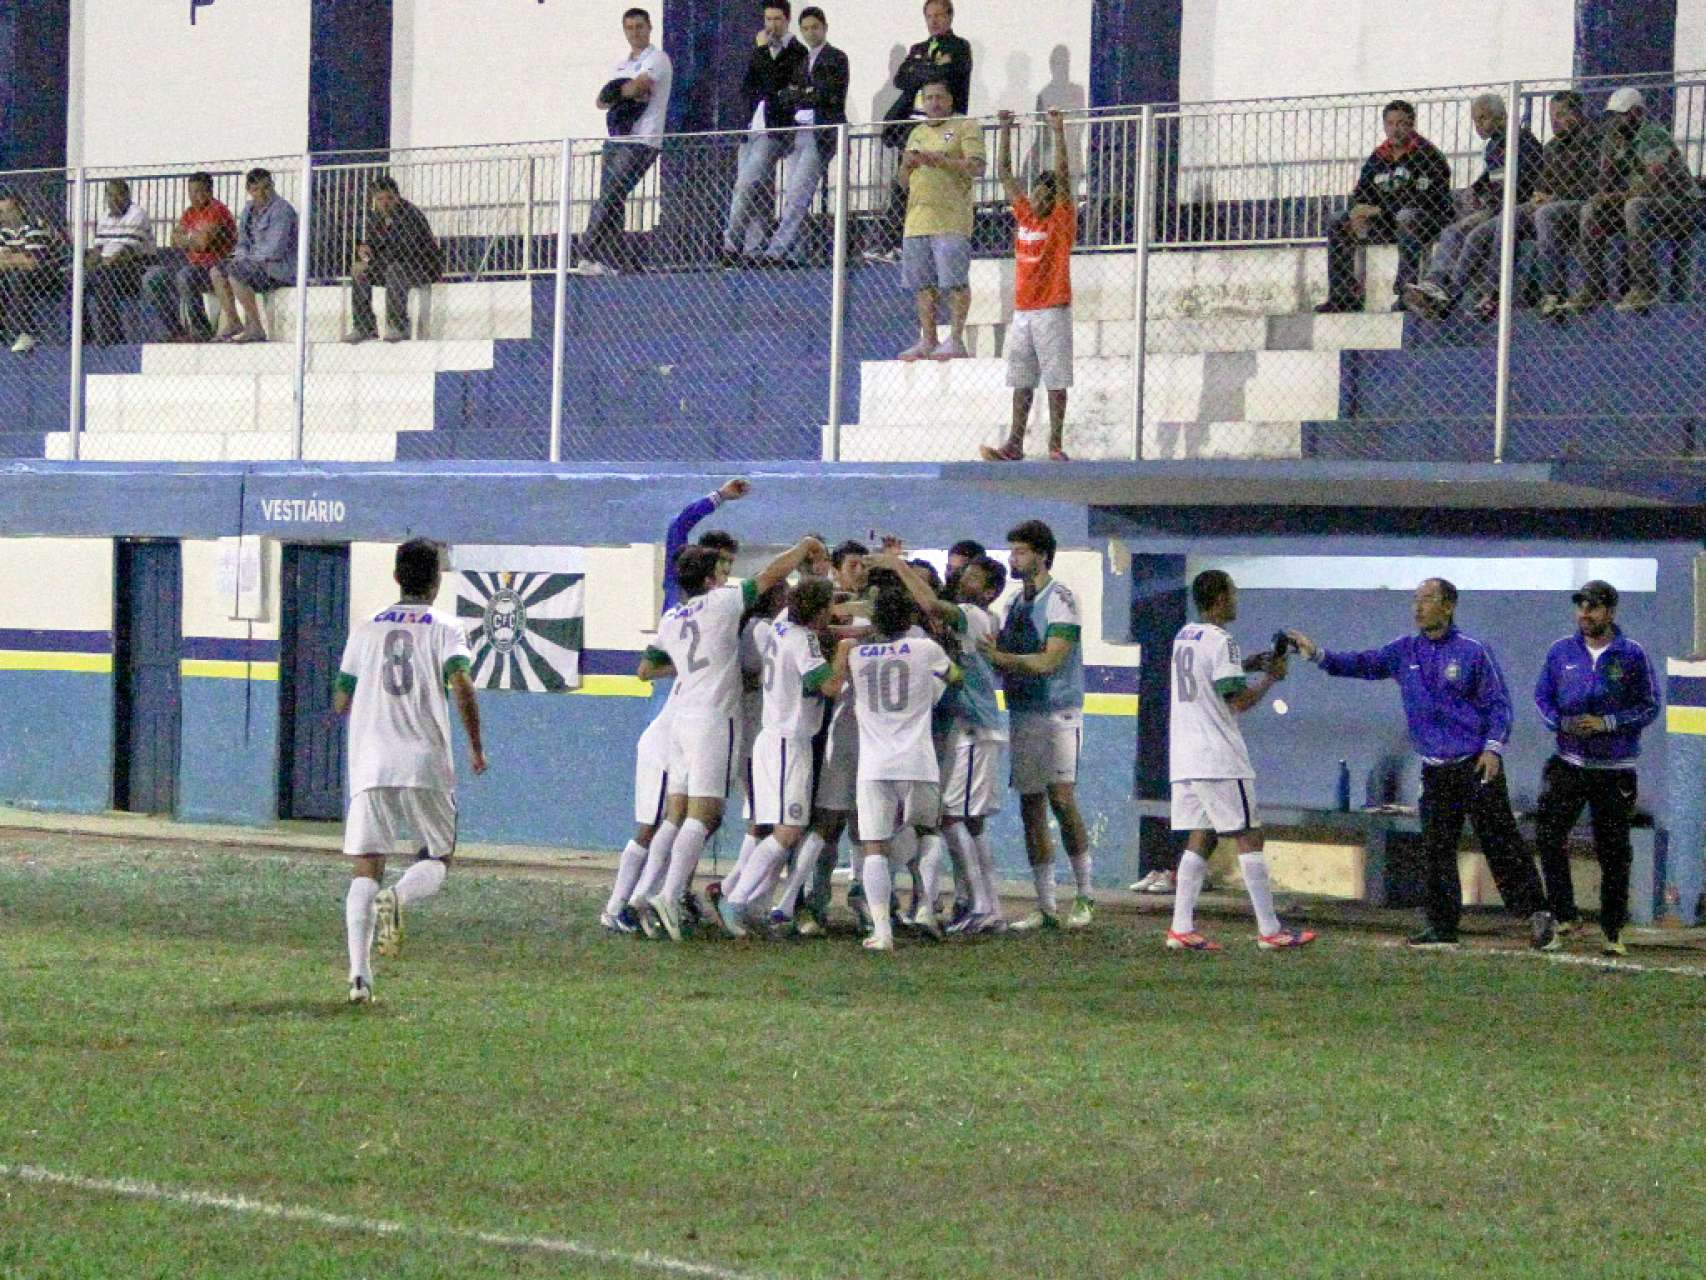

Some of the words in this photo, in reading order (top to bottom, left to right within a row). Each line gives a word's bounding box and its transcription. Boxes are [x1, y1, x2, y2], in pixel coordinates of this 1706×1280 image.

[261, 493, 346, 523] VESTIÁRIO
[382, 629, 414, 696] 8
[680, 619, 710, 673] 2
[860, 643, 911, 657] CAIXA
[859, 659, 909, 713] 10
